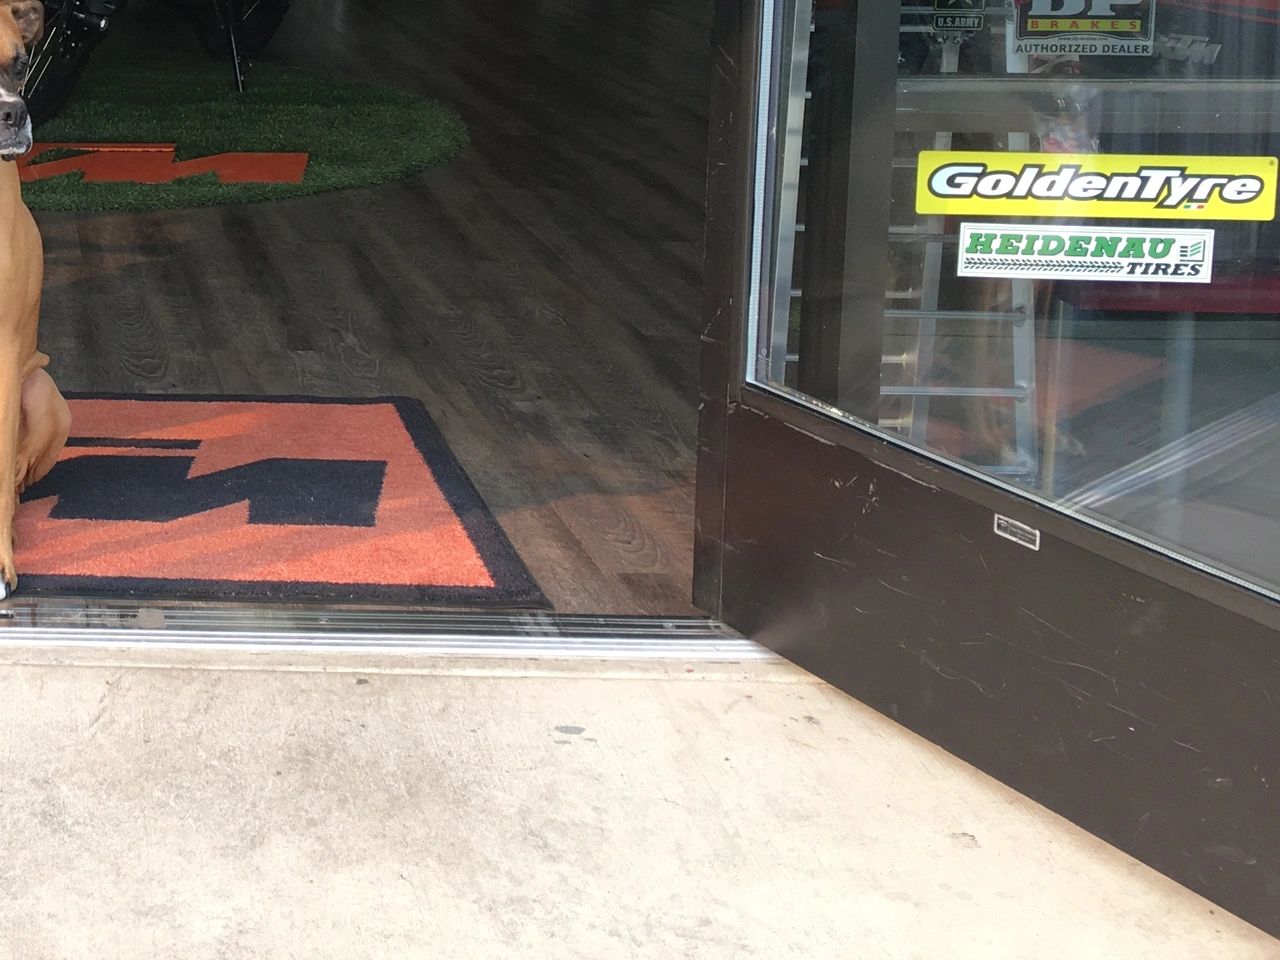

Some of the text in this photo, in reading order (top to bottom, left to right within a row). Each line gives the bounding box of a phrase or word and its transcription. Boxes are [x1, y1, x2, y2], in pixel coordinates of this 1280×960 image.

[1031, 20, 1137, 30] BRAKES
[1016, 43, 1150, 54] AUTHORIZED DEALER
[928, 162, 1264, 209] GoldenTyre
[965, 232, 1176, 259] HEIDENAU
[1126, 262, 1204, 277] TIRES
